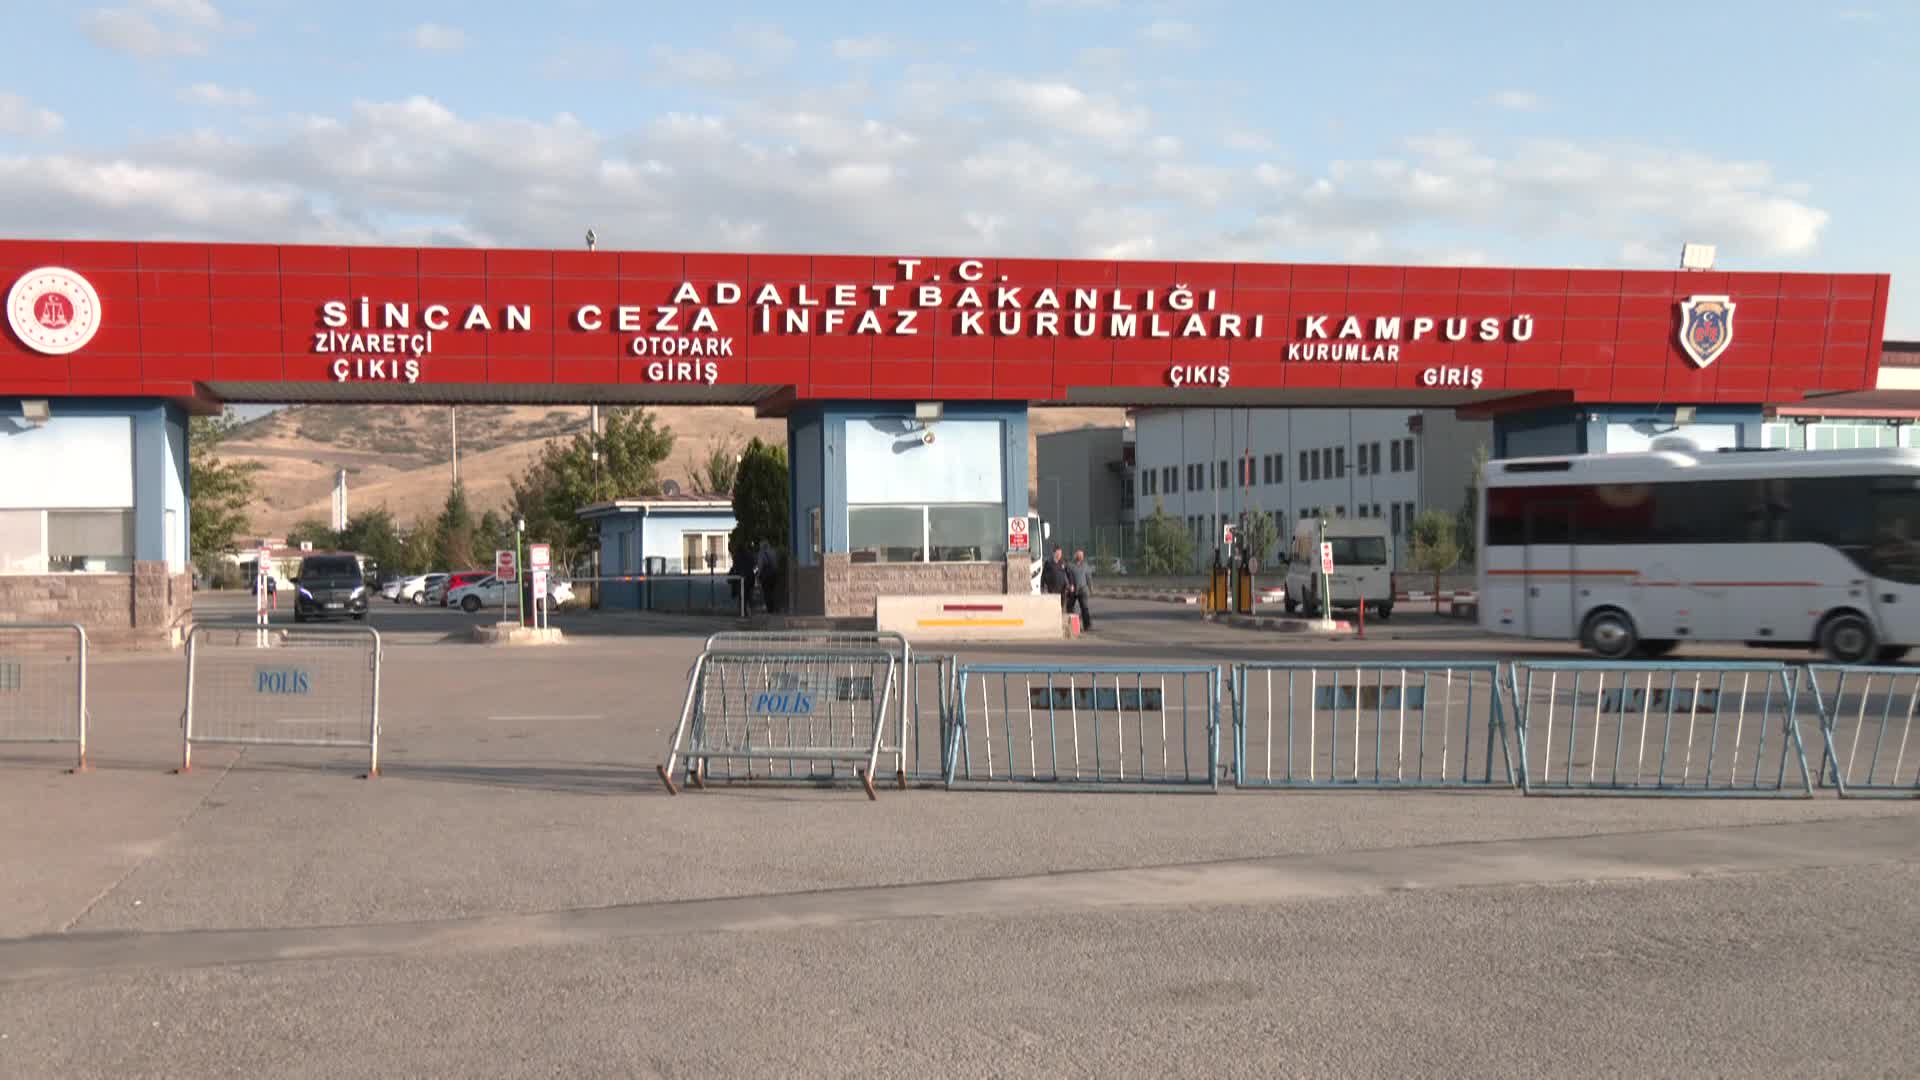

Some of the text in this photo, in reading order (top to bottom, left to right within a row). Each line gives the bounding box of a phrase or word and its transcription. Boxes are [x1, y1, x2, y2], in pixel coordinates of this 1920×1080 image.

[897, 258, 1009, 283] T.C.
[673, 281, 1217, 311] ADALET BAKANLIĞI
[322, 295, 1535, 342] SİNCAN CEZA İNFAZ KURUMLARI KAMPUSÜ
[314, 329, 432, 358] ZİYARETÇİ
[632, 336, 734, 356] OTOPARK
[1287, 342, 1401, 362] KURUMLAR
[333, 358, 420, 384] ÇIKIŞ
[647, 357, 718, 387] GİRİŞ
[1169, 364, 1230, 388] ÇIKIŞ
[1423, 364, 1484, 390] GİRİŞ
